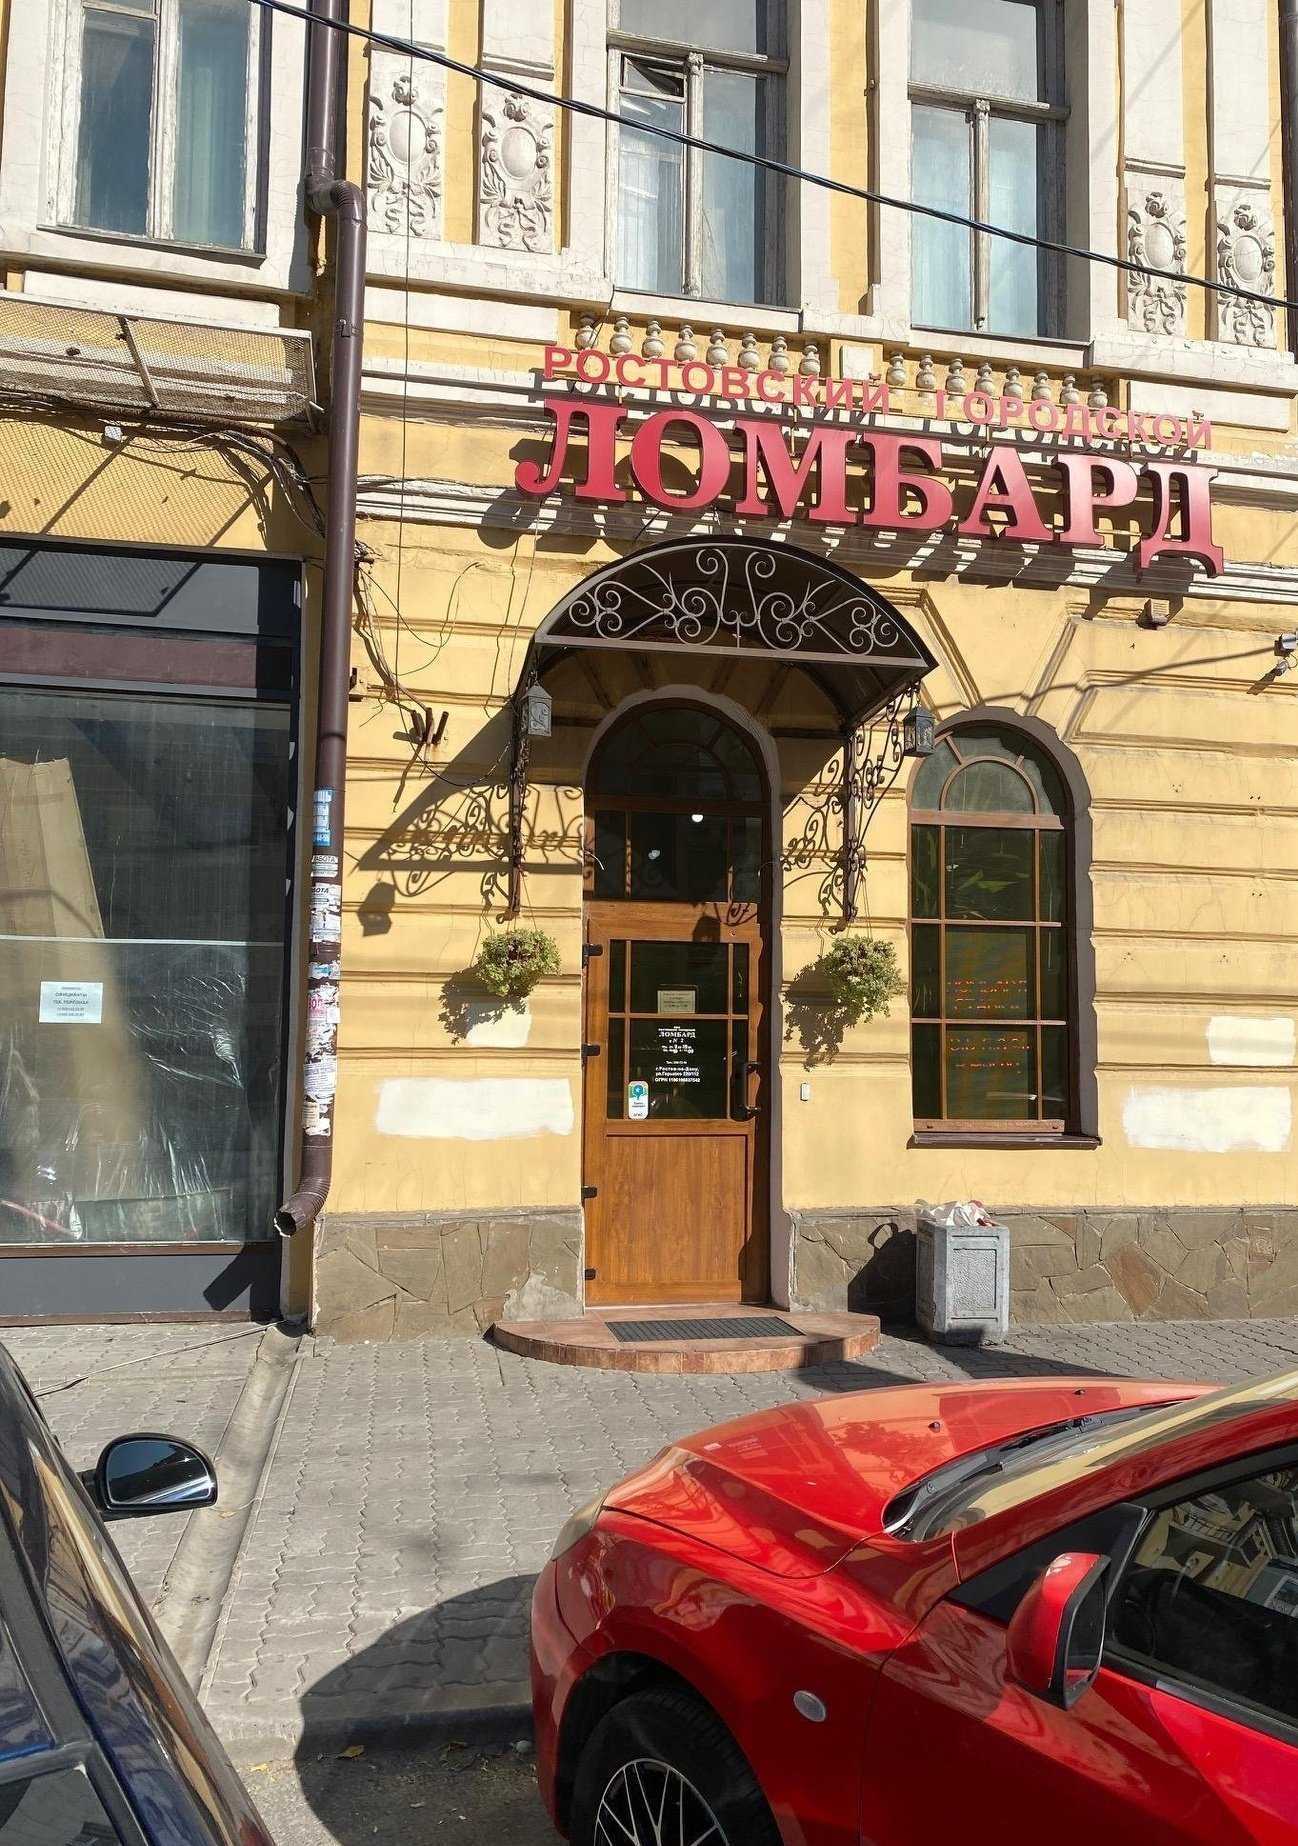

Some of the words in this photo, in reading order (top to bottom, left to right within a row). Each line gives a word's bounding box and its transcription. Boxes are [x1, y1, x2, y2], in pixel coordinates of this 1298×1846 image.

[543, 346, 890, 415] РОСТОВСКИЙ
[936, 389, 1212, 449] ГОРОДСКОЙ
[514, 396, 1225, 578] ЛОМБАРД
